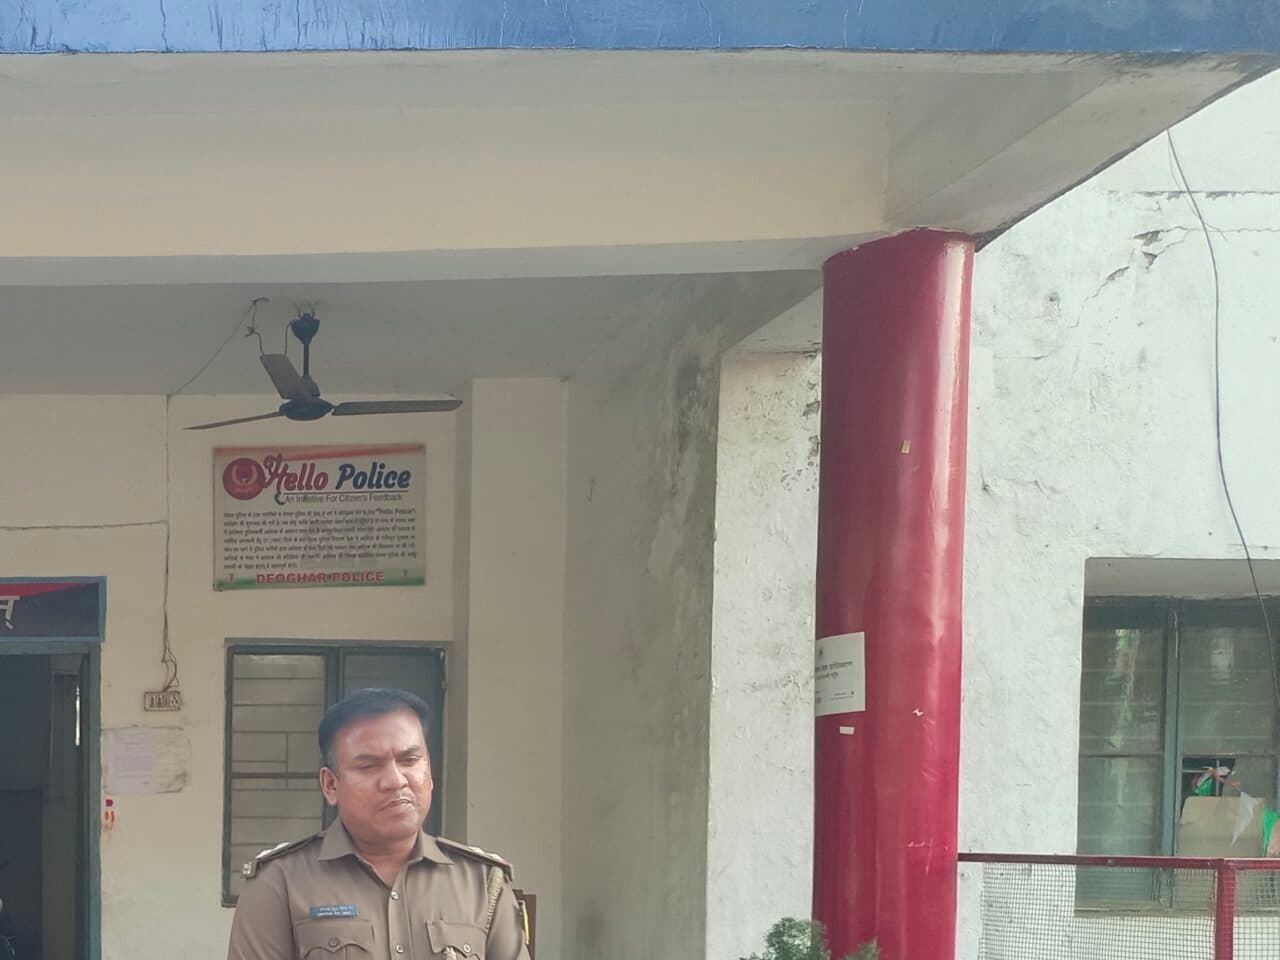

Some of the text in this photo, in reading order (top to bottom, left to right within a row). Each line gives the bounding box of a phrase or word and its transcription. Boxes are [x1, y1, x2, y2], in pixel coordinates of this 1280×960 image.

[263, 453, 411, 493] Hello Police
[256, 571, 384, 584] DEOGHAR POLICE
